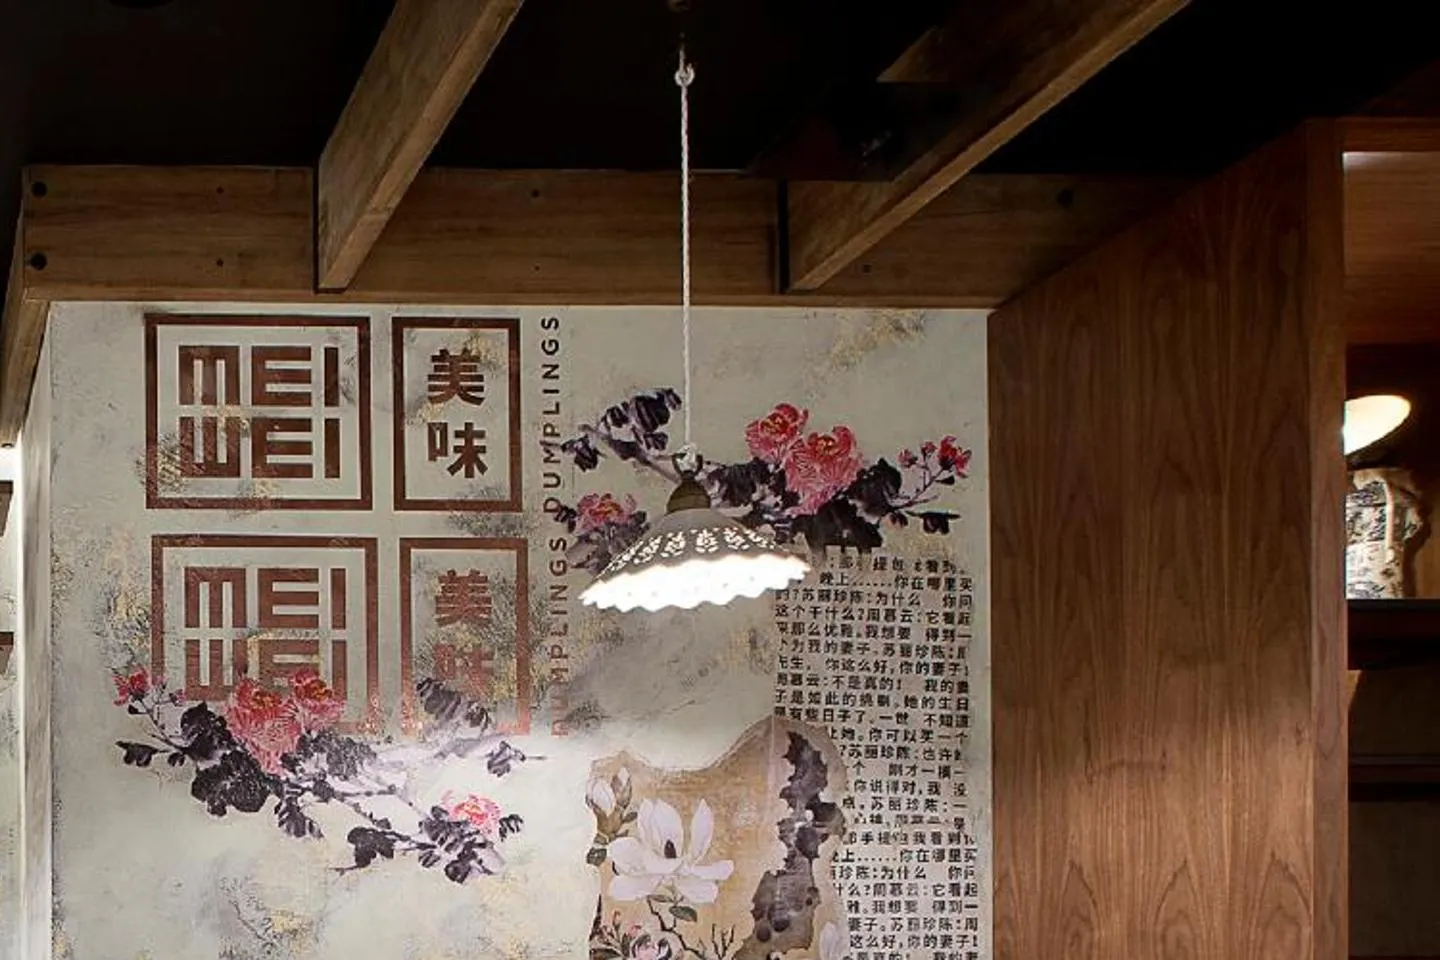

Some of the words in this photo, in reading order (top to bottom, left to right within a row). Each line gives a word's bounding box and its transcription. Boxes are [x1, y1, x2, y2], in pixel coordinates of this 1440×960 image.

[178, 345, 339, 407] MEI
[426, 348, 487, 479] 美味
[541, 315, 561, 514] DUMPLINGS
[179, 417, 340, 479] WEI
[185, 567, 346, 630] MEI
